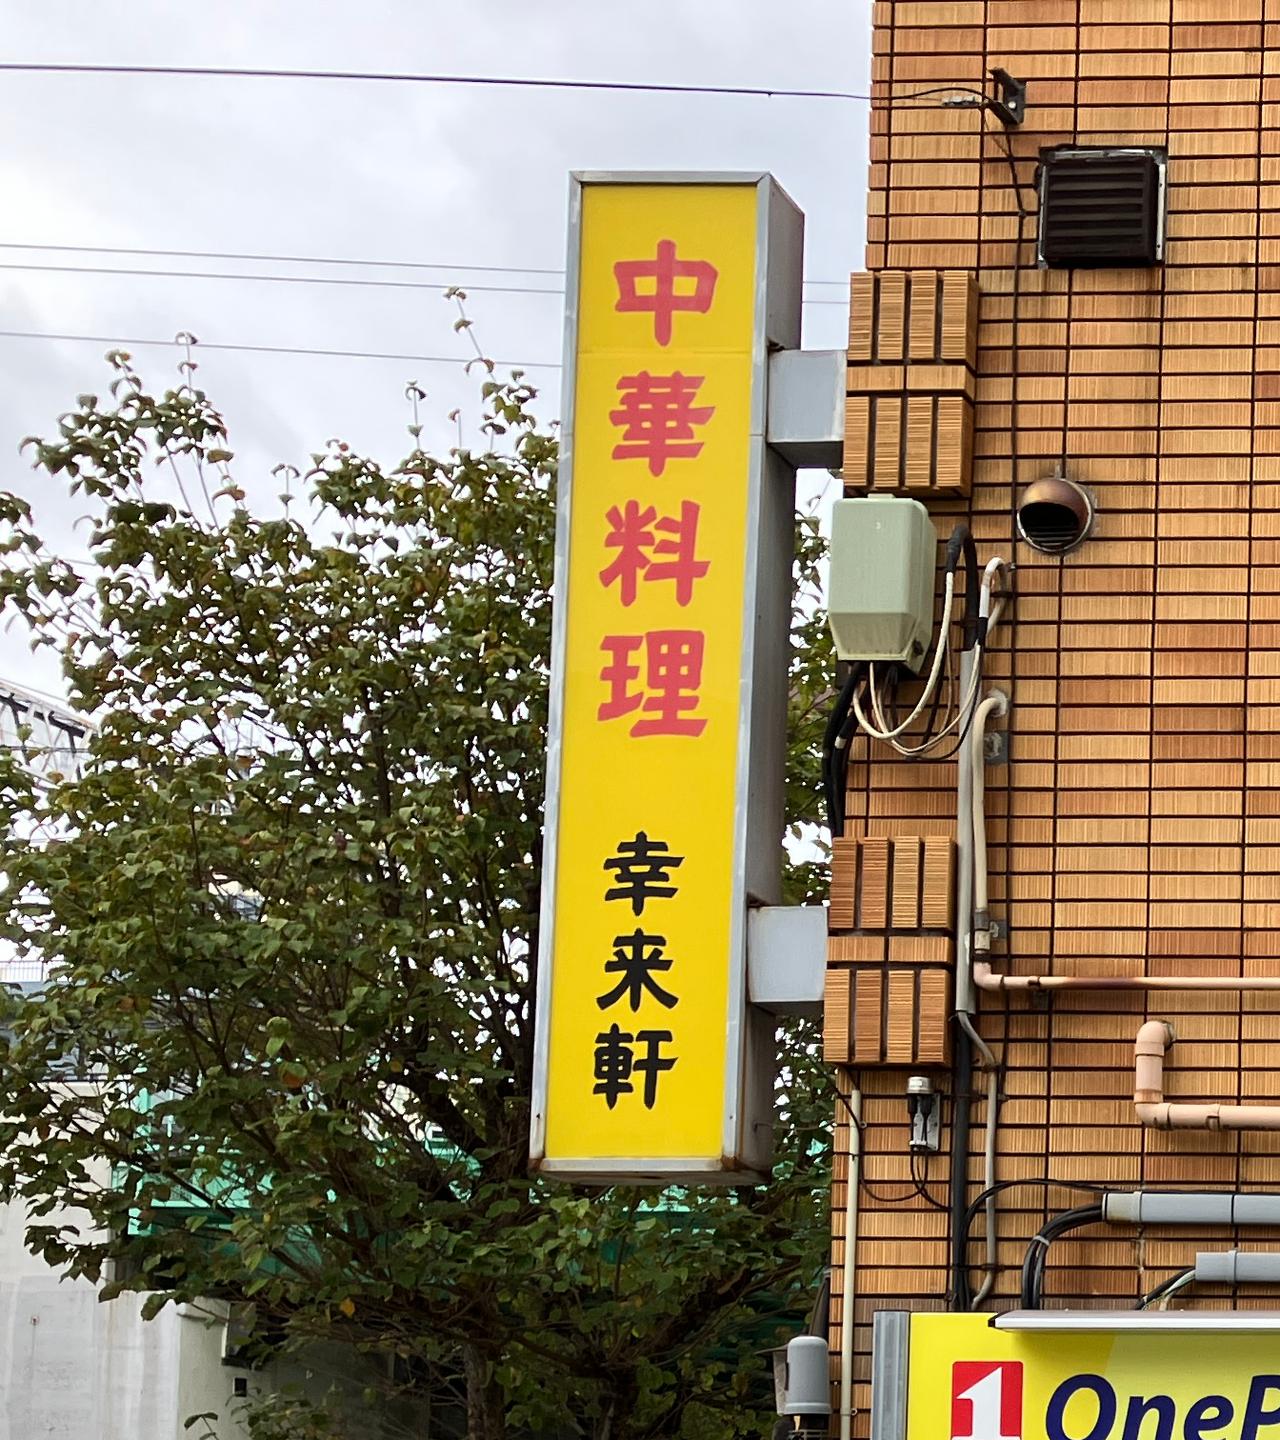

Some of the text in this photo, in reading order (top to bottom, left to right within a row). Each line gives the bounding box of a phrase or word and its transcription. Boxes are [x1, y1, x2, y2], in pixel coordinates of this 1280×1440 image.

[598, 239, 719, 738] 中華料理
[593, 831, 685, 1110] 幸来軒
